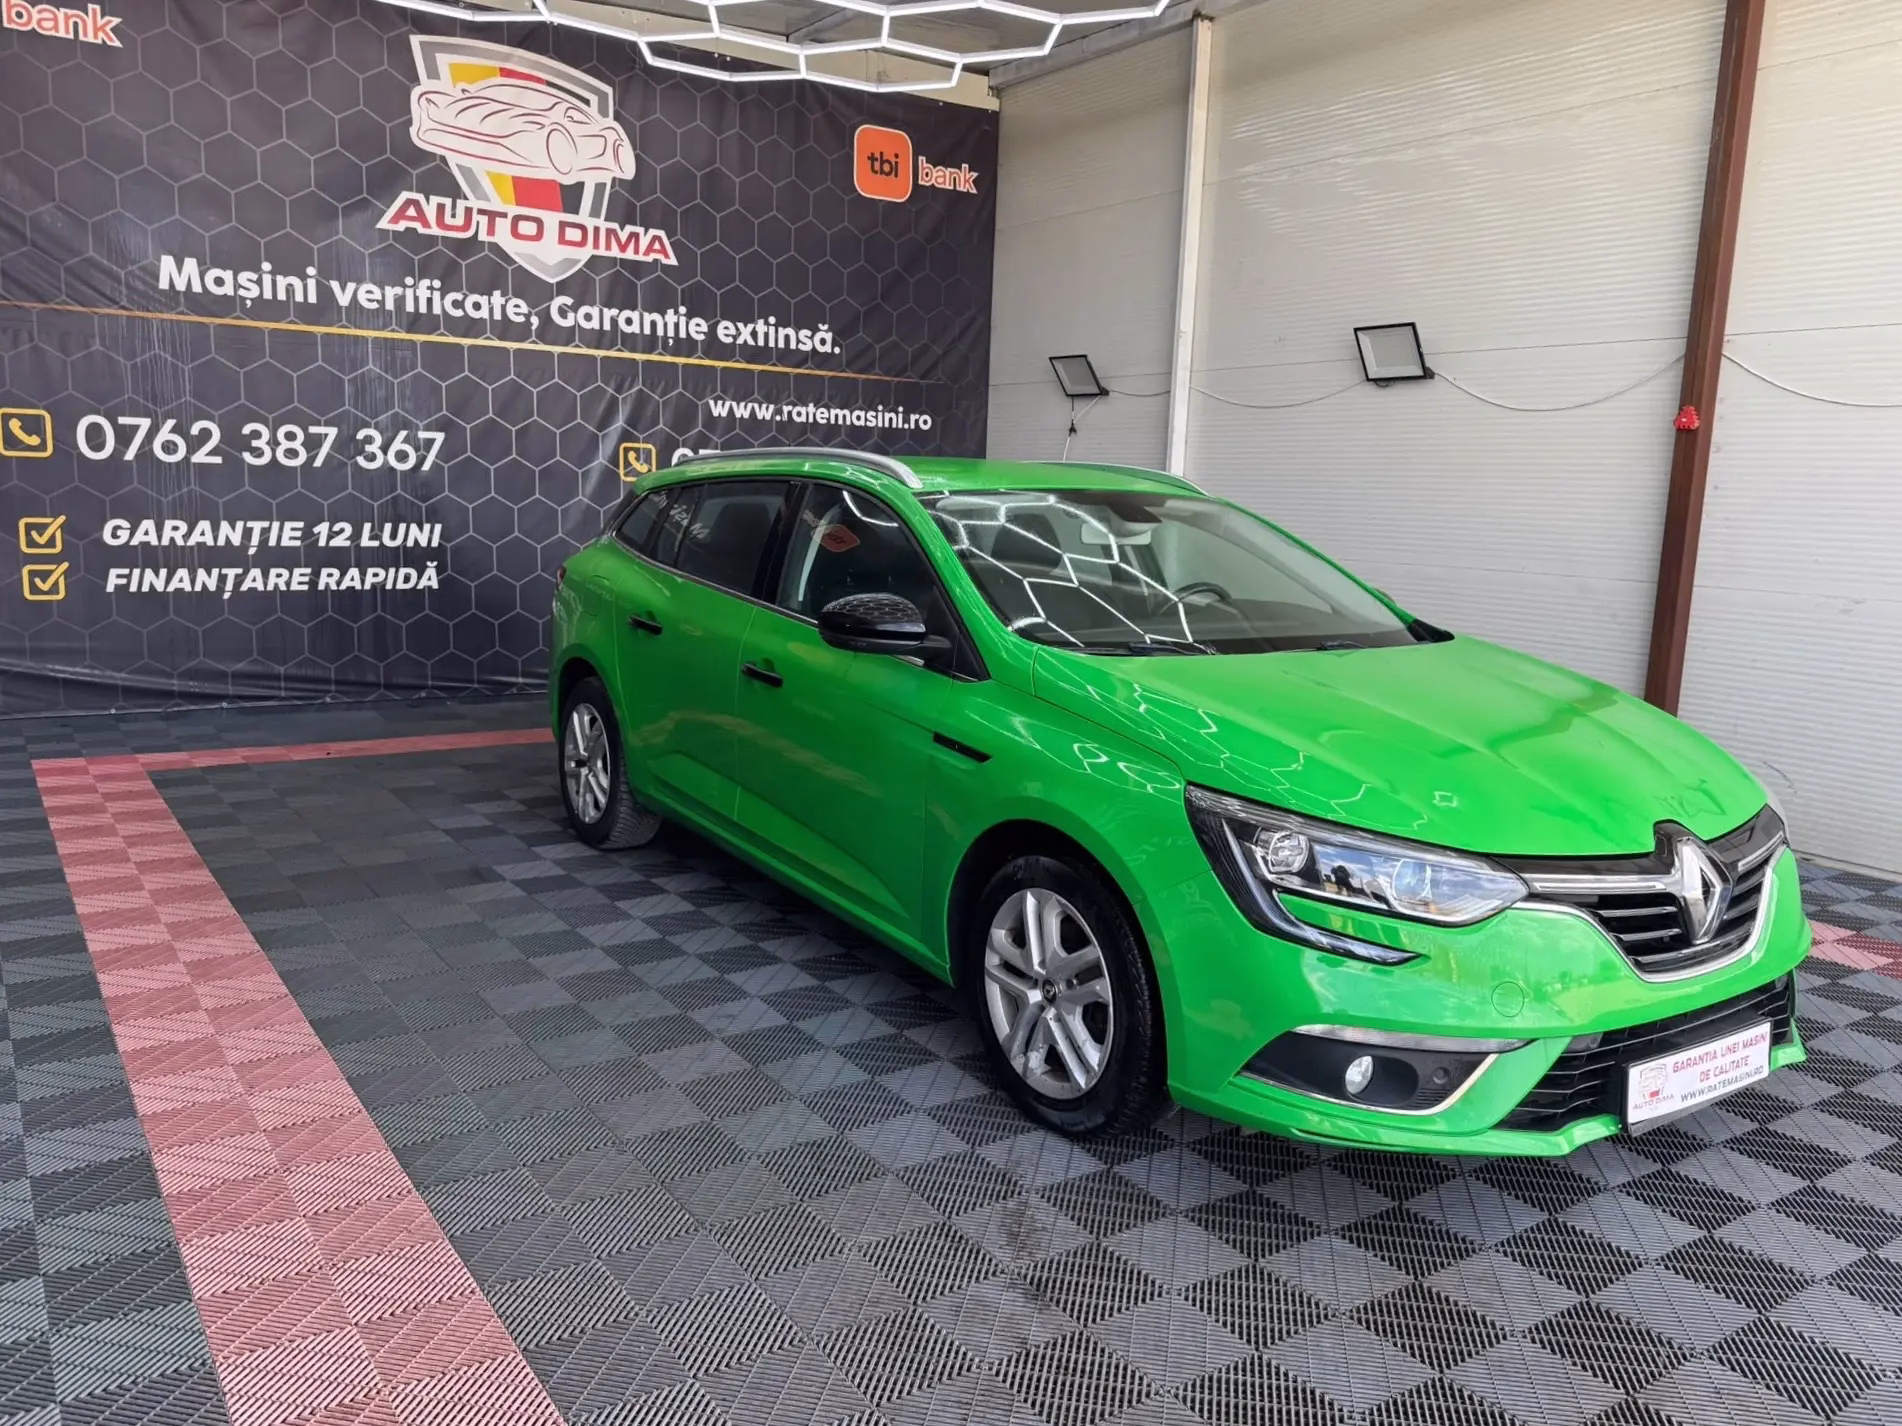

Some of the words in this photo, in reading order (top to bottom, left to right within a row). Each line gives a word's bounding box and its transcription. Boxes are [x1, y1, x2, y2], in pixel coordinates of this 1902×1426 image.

[1, 0, 123, 47] bank
[866, 151, 900, 179] tbi
[918, 156, 979, 194] bank
[383, 195, 546, 243] AUTO
[556, 218, 674, 262] DIMA
[158, 255, 318, 308] Mașini
[328, 276, 540, 330] verificate,
[549, 295, 709, 347] Garanție
[715, 315, 841, 355] extinsă.
[708, 399, 933, 431] www.ratemasini.ro
[75, 414, 224, 465] 0762
[240, 422, 339, 468] 387
[355, 428, 447, 472] 367
[102, 518, 304, 555] GARANȚIE
[311, 521, 353, 547] 12
[359, 521, 443, 548] LUNI
[105, 566, 312, 600] FINANȚARE
[316, 561, 440, 590] RAPIDĂ
[1672, 1049, 1718, 1073] GARANTIA
[1699, 1068, 1712, 1083] DE
[1680, 1065, 1764, 1103] WWW.RATEMASINI.RO
